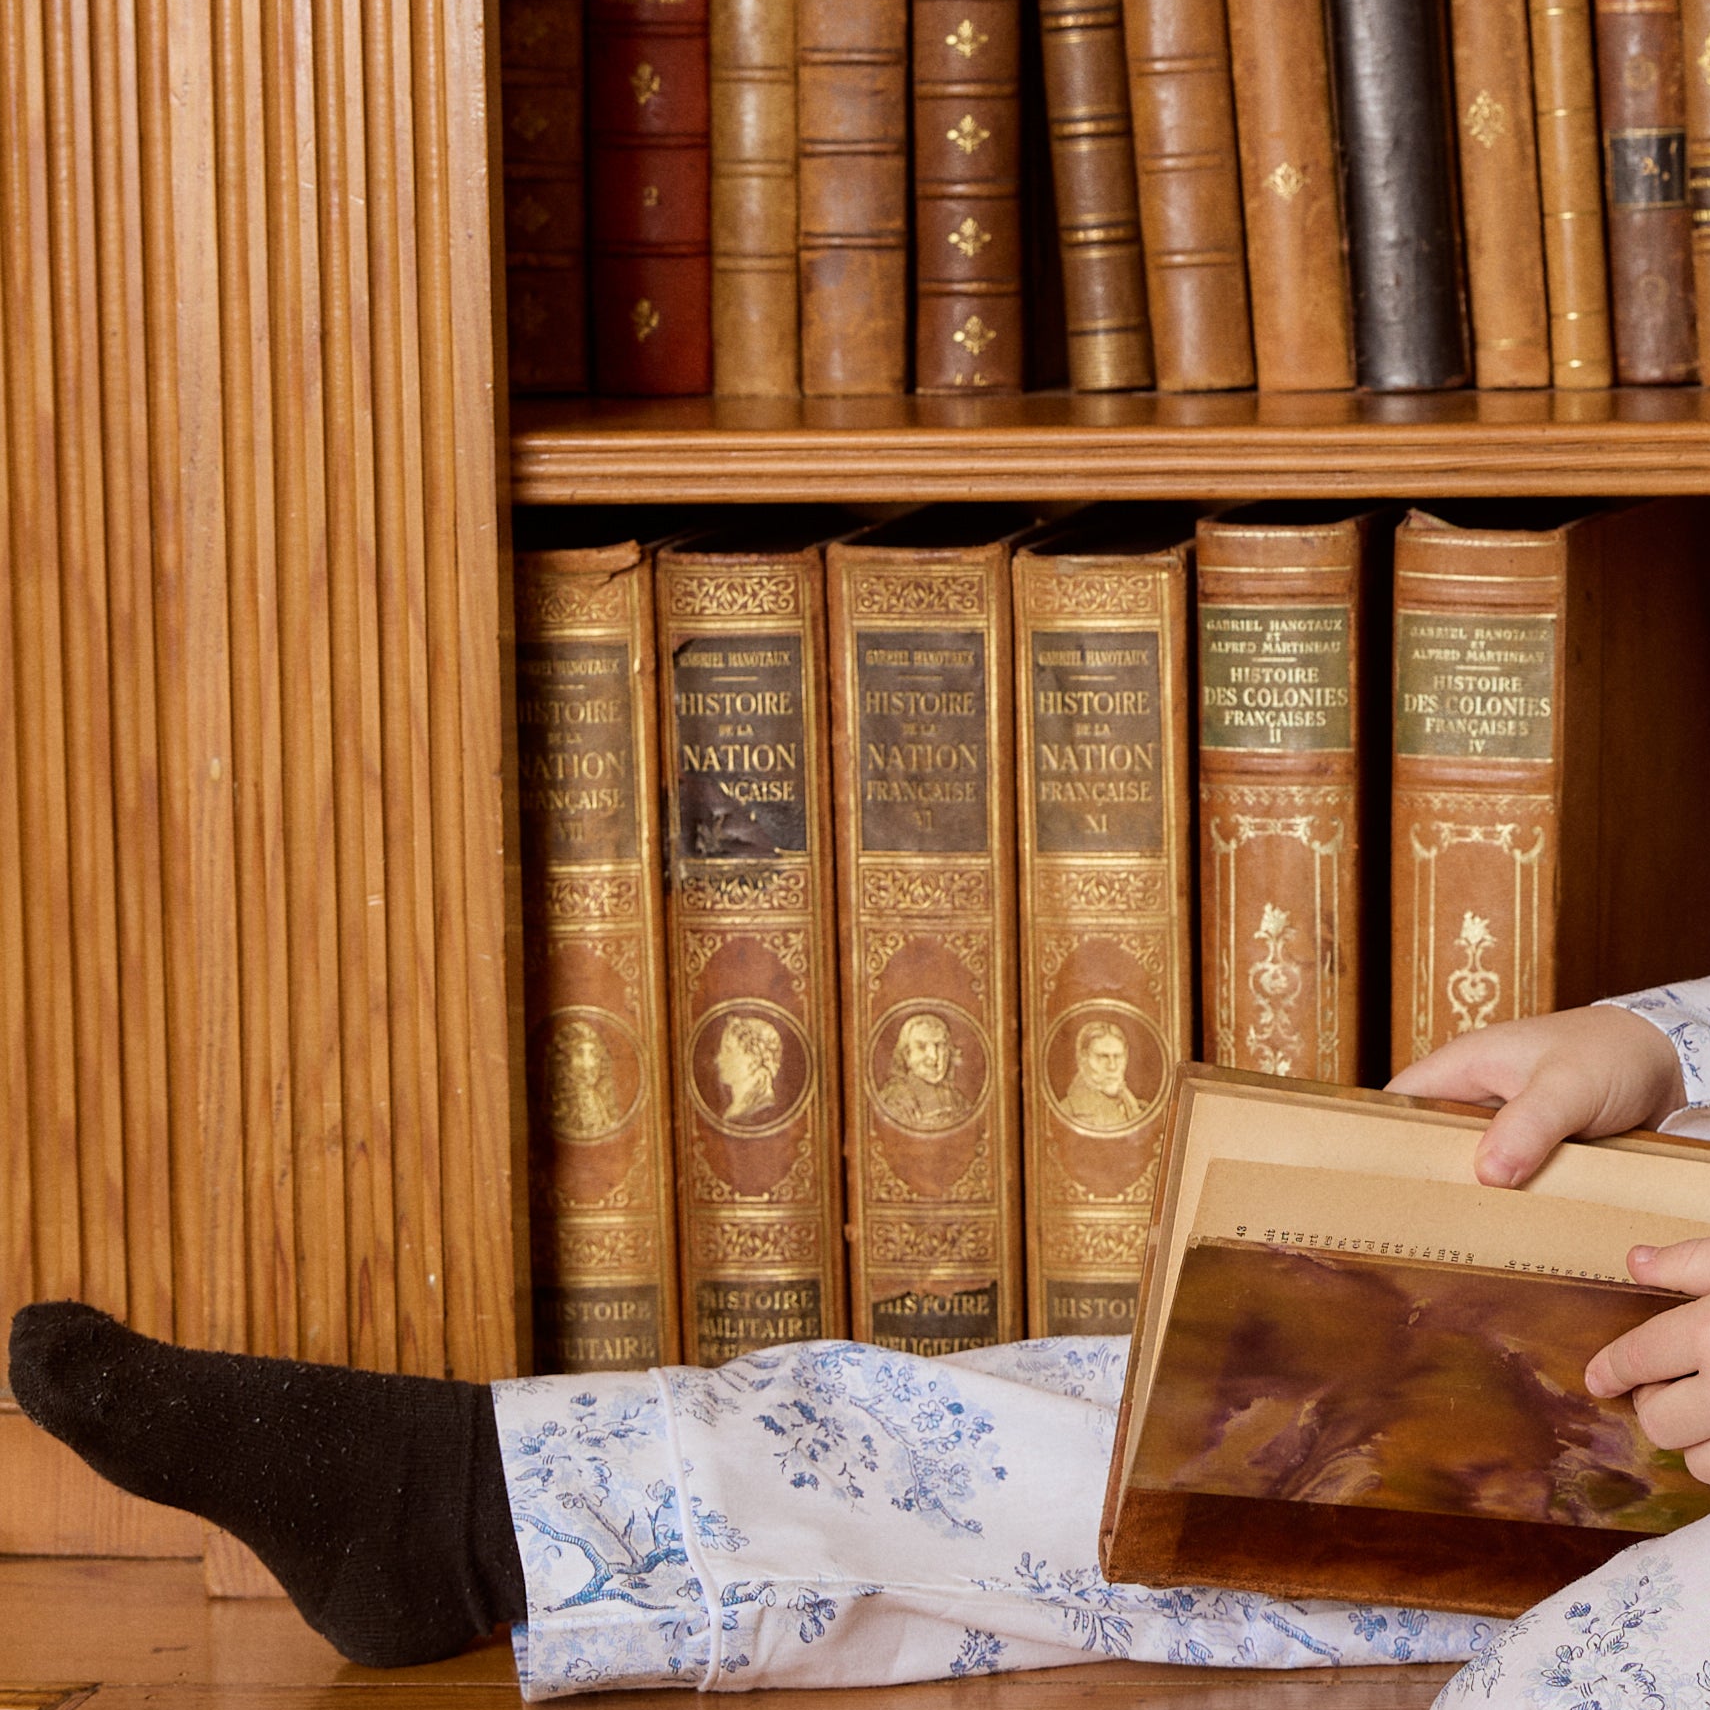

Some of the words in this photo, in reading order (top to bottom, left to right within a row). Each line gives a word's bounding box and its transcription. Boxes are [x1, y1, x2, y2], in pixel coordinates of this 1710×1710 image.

[1206, 619, 1263, 632] GABRIEL
[1269, 619, 1342, 631] HANOTAUX
[1410, 626, 1468, 640] GABRIEL
[1266, 632, 1281, 642] ET
[1470, 641, 1486, 650] ET
[1086, 649, 1149, 666] HANOTAUX
[1210, 641, 1257, 653] ALFRED
[1261, 641, 1341, 654] MARTINEAU
[1412, 649, 1460, 662] ALFRED
[1466, 650, 1545, 663] MARTINEAU
[519, 660, 553, 676] RIEL
[728, 650, 791, 667] HANOTAUX
[1230, 667, 1320, 683] HISTOIRE
[1433, 675, 1523, 692] HISTOIRE
[679, 692, 793, 716] HISTOIRE
[866, 691, 976, 716] HISTOIRE
[1039, 691, 1150, 716] HISTOIRE
[1204, 686, 1238, 706] DES
[1243, 687, 1348, 708] COLONIES
[1404, 693, 1439, 714] DES
[1446, 695, 1551, 717] COLONIES
[1224, 710, 1327, 728] FRANÇAISES
[1425, 717, 1529, 737] FRANÇAISES
[719, 724, 733, 737] DE
[736, 723, 753, 737] LA
[902, 723, 917, 736] DE
[921, 723, 938, 736] LA
[1076, 723, 1090, 736] DE
[1093, 723, 1111, 736] LA
[1269, 728, 1282, 743] II
[1469, 739, 1486, 753] IV
[682, 743, 796, 772] NATION
[868, 743, 978, 772] NATION
[1040, 742, 1156, 772] NATION
[522, 789, 626, 814] ANÇAISE
[720, 781, 795, 806] NÇAISE
[867, 780, 976, 805] FRANÇAISE
[1041, 780, 1151, 806] FRANÇAISE
[702, 1290, 814, 1311] HISTOIRE
[1053, 1296, 1135, 1319] HISTOI
[556, 1300, 651, 1322] STOIRE
[701, 1317, 819, 1339] MILITAIRE
[556, 1336, 655, 1360] LITAIRE
